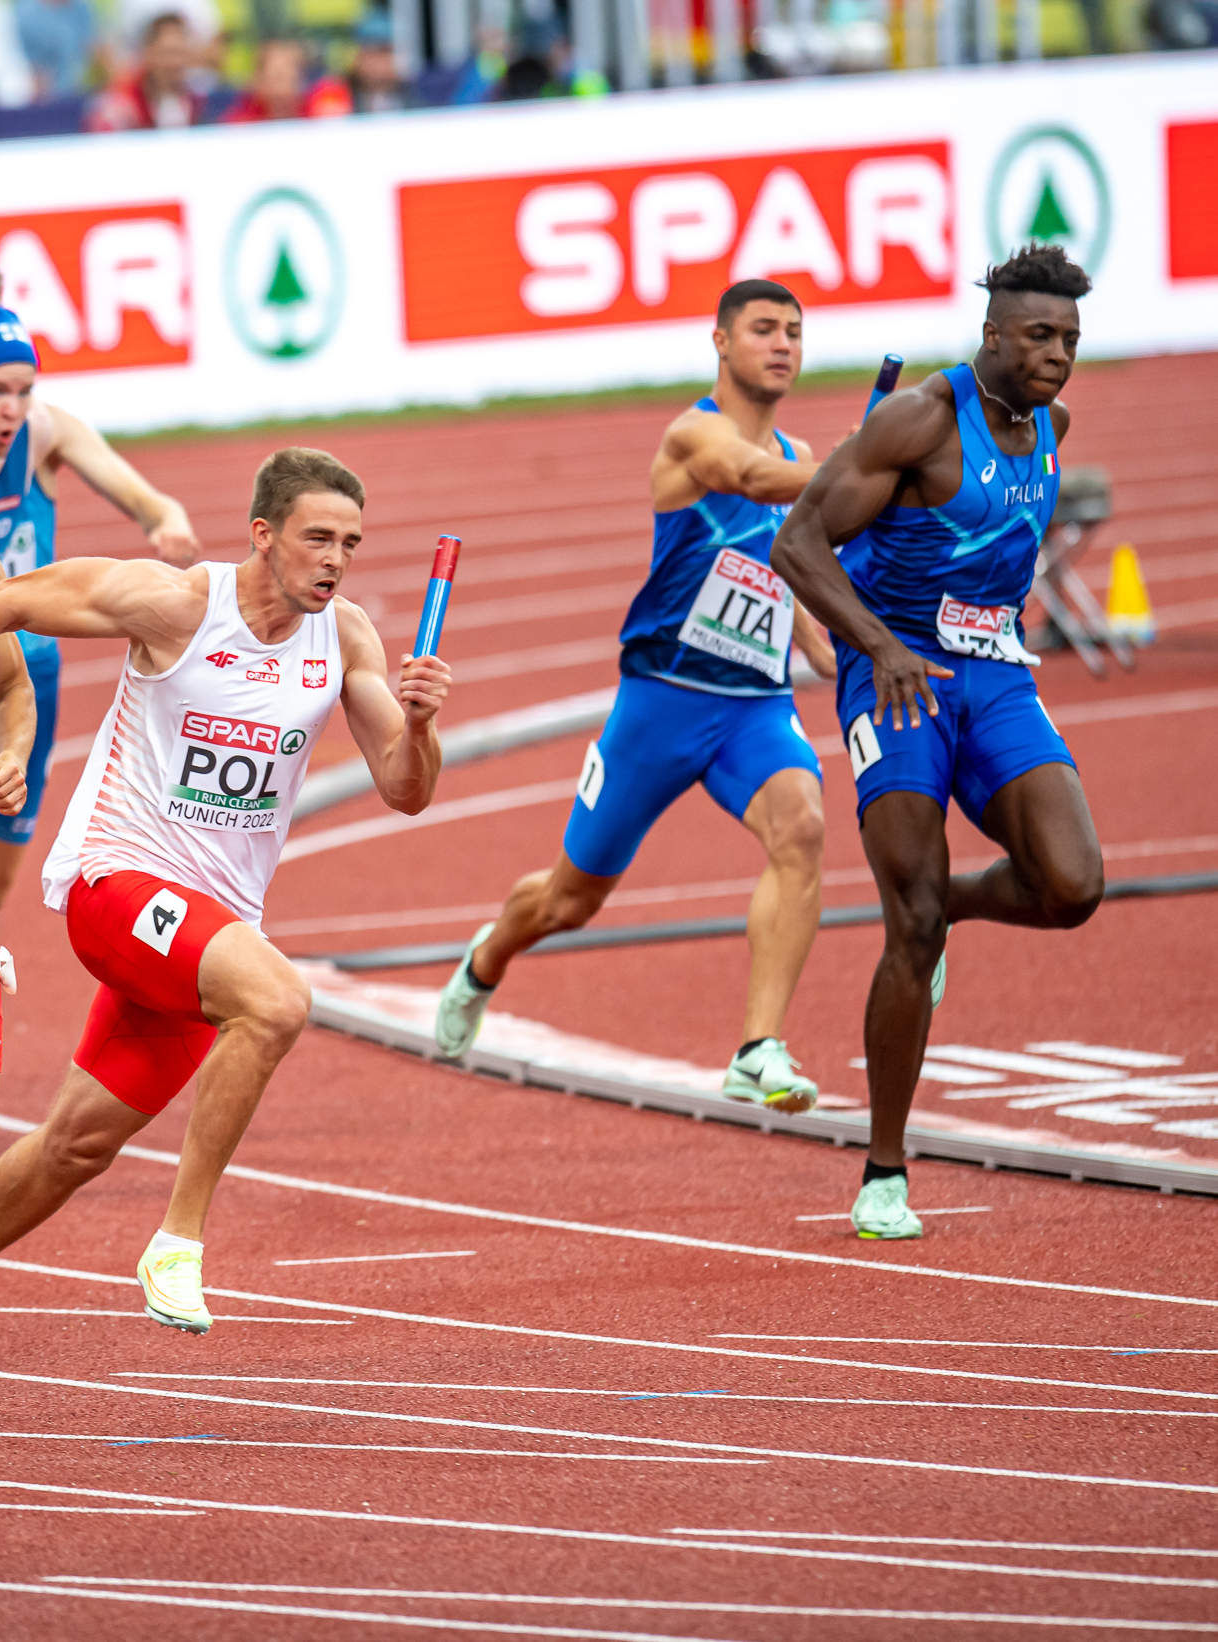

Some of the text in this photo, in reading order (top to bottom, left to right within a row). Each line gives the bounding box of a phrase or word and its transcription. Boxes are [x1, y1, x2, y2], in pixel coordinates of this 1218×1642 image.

[515, 154, 954, 318] SPAR
[1004, 483, 1044, 505] ITALIA
[720, 555, 785, 600] SPAR
[717, 588, 774, 645] ITA
[205, 650, 239, 668] 4F
[247, 671, 278, 683] ORLEN
[184, 715, 277, 751] SPAR
[853, 731, 867, 765] 1
[179, 745, 279, 799] POL
[584, 762, 596, 792] 1
[168, 800, 274, 828] MUNICH 2022
[194, 791, 200, 801] I
[202, 792, 227, 806] RUN
[152, 904, 178, 936] 4
